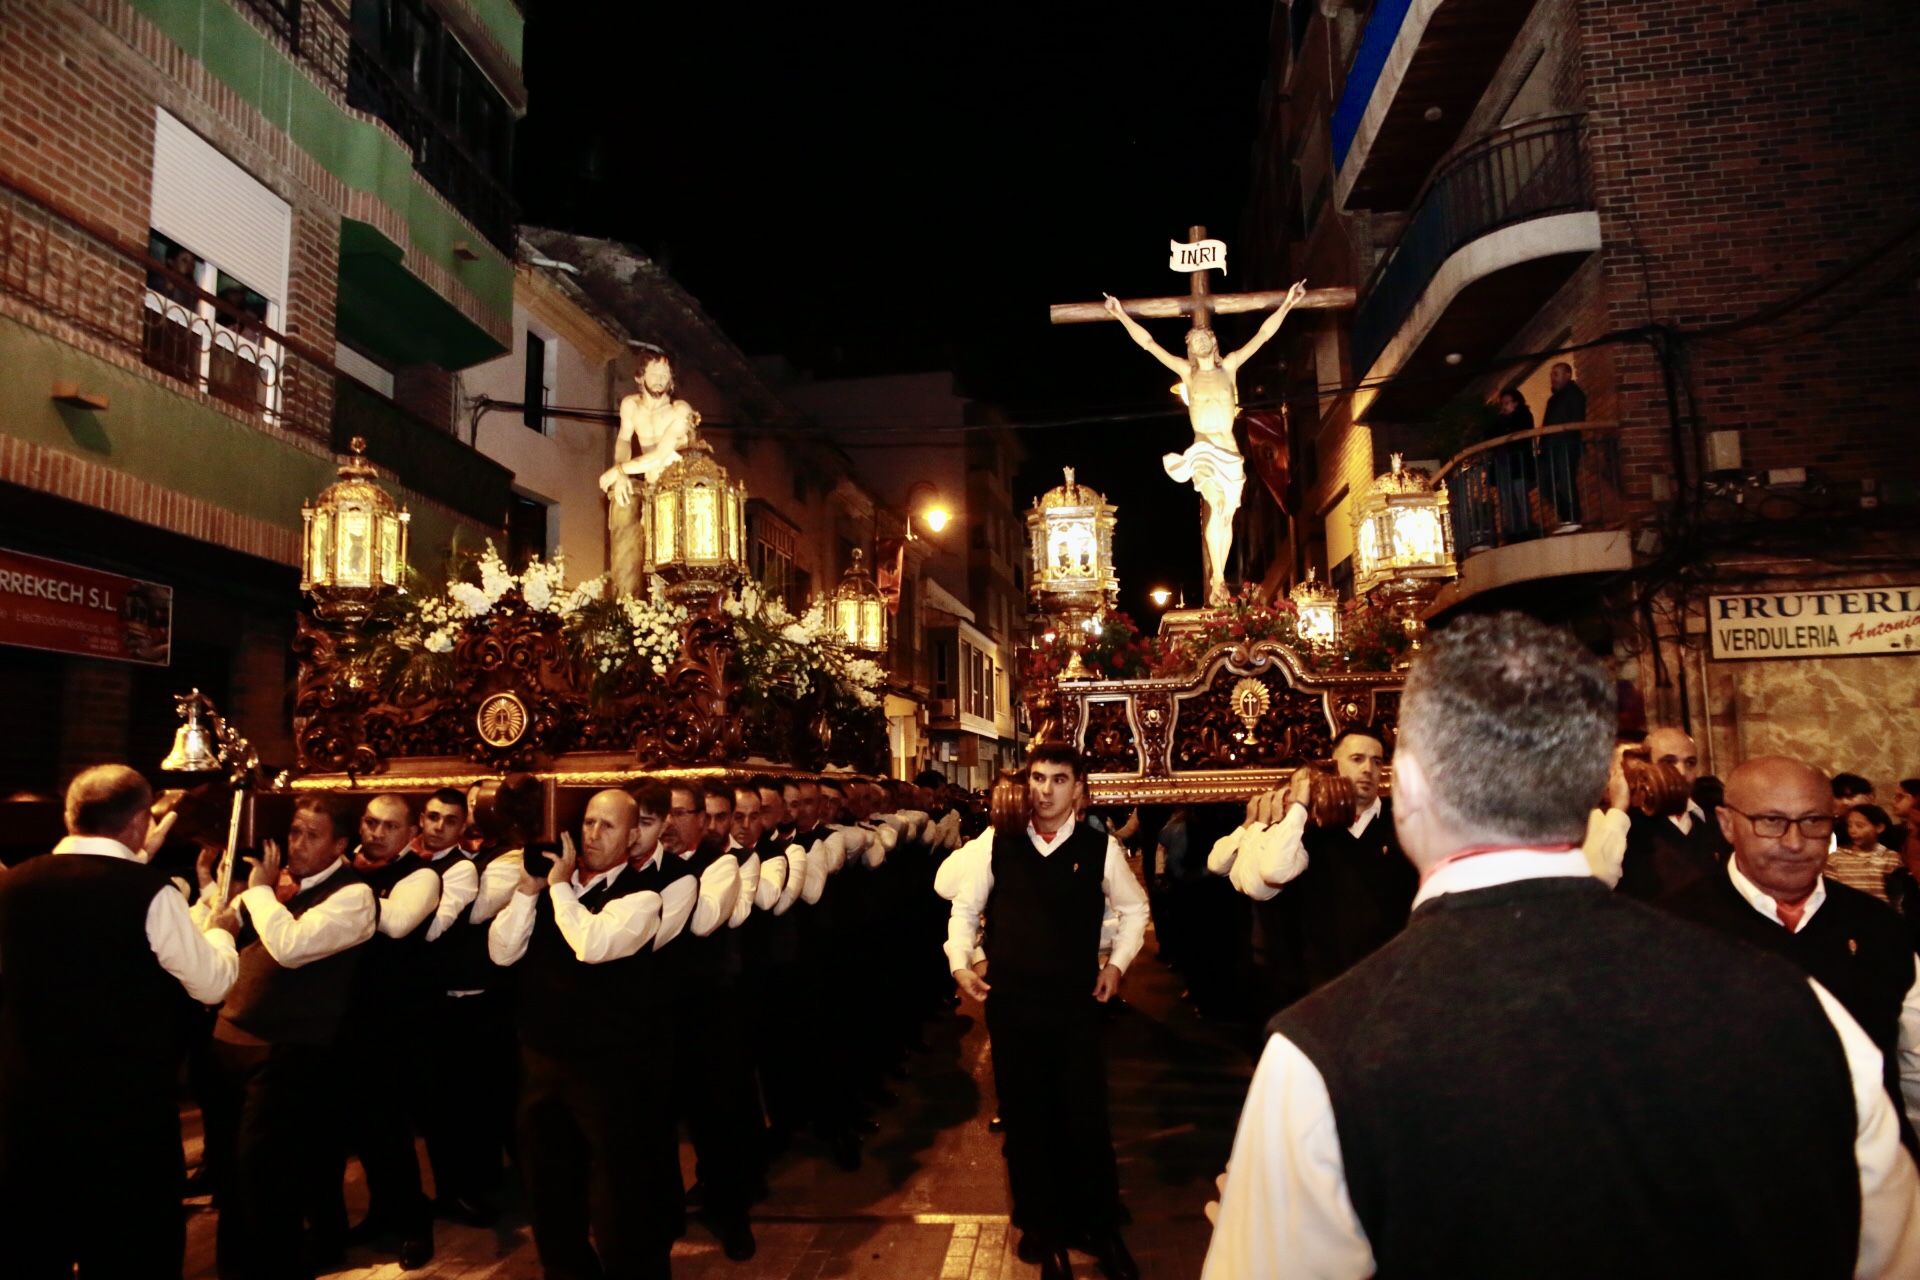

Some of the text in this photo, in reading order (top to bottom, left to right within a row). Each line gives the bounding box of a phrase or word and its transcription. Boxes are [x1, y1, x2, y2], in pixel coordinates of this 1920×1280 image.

[1181, 246, 1216, 265] INRI
[1715, 590, 1920, 619] FRUTERI
[1719, 625, 1840, 652] VERDULERIA
